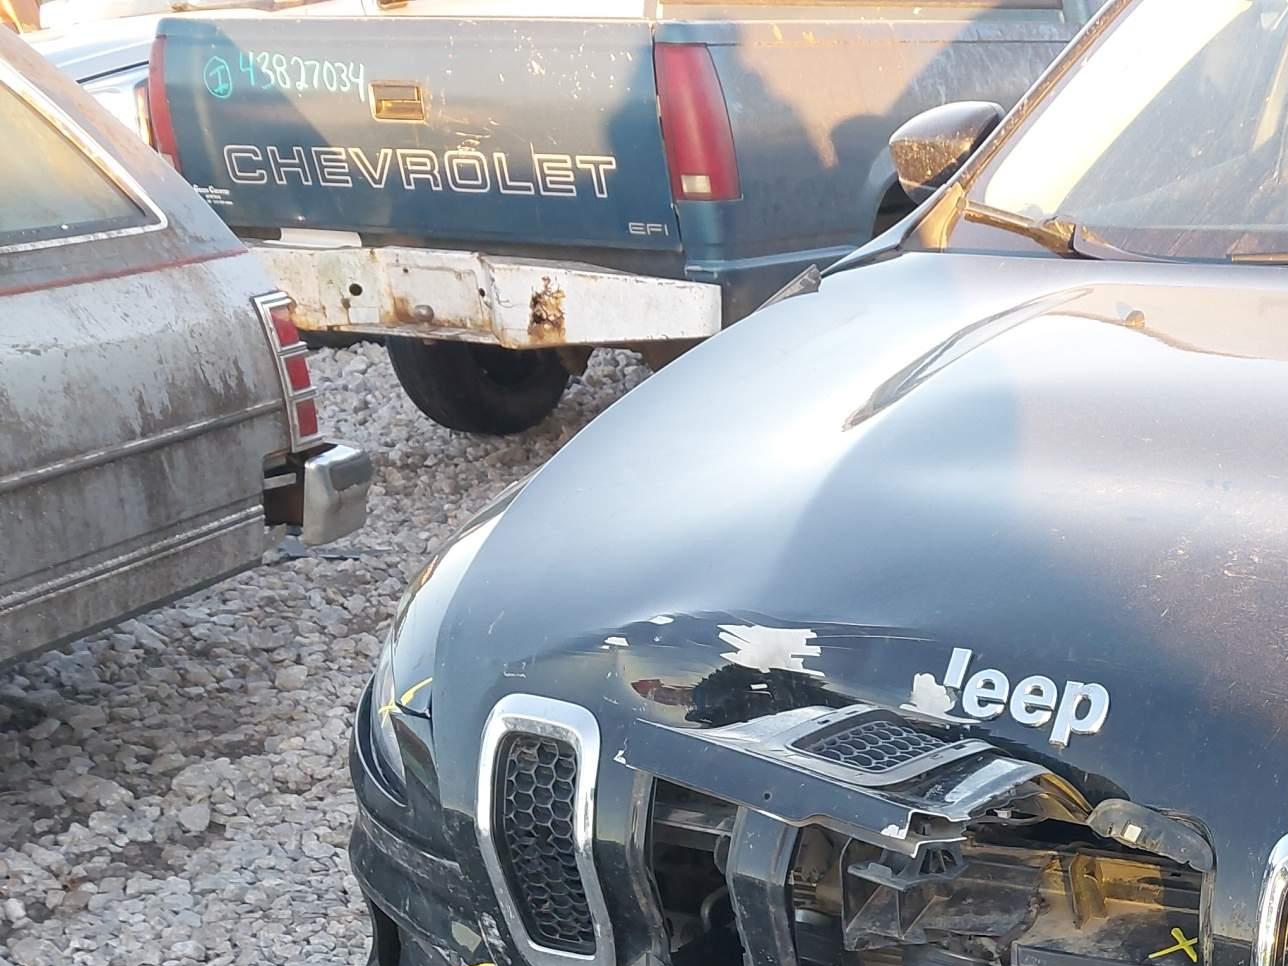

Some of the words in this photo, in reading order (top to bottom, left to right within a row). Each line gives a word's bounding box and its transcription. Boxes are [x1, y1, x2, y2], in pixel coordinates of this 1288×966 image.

[239, 51, 366, 102] 43827034
[223, 144, 616, 198] CHEVROLET
[628, 222, 669, 236] EFI
